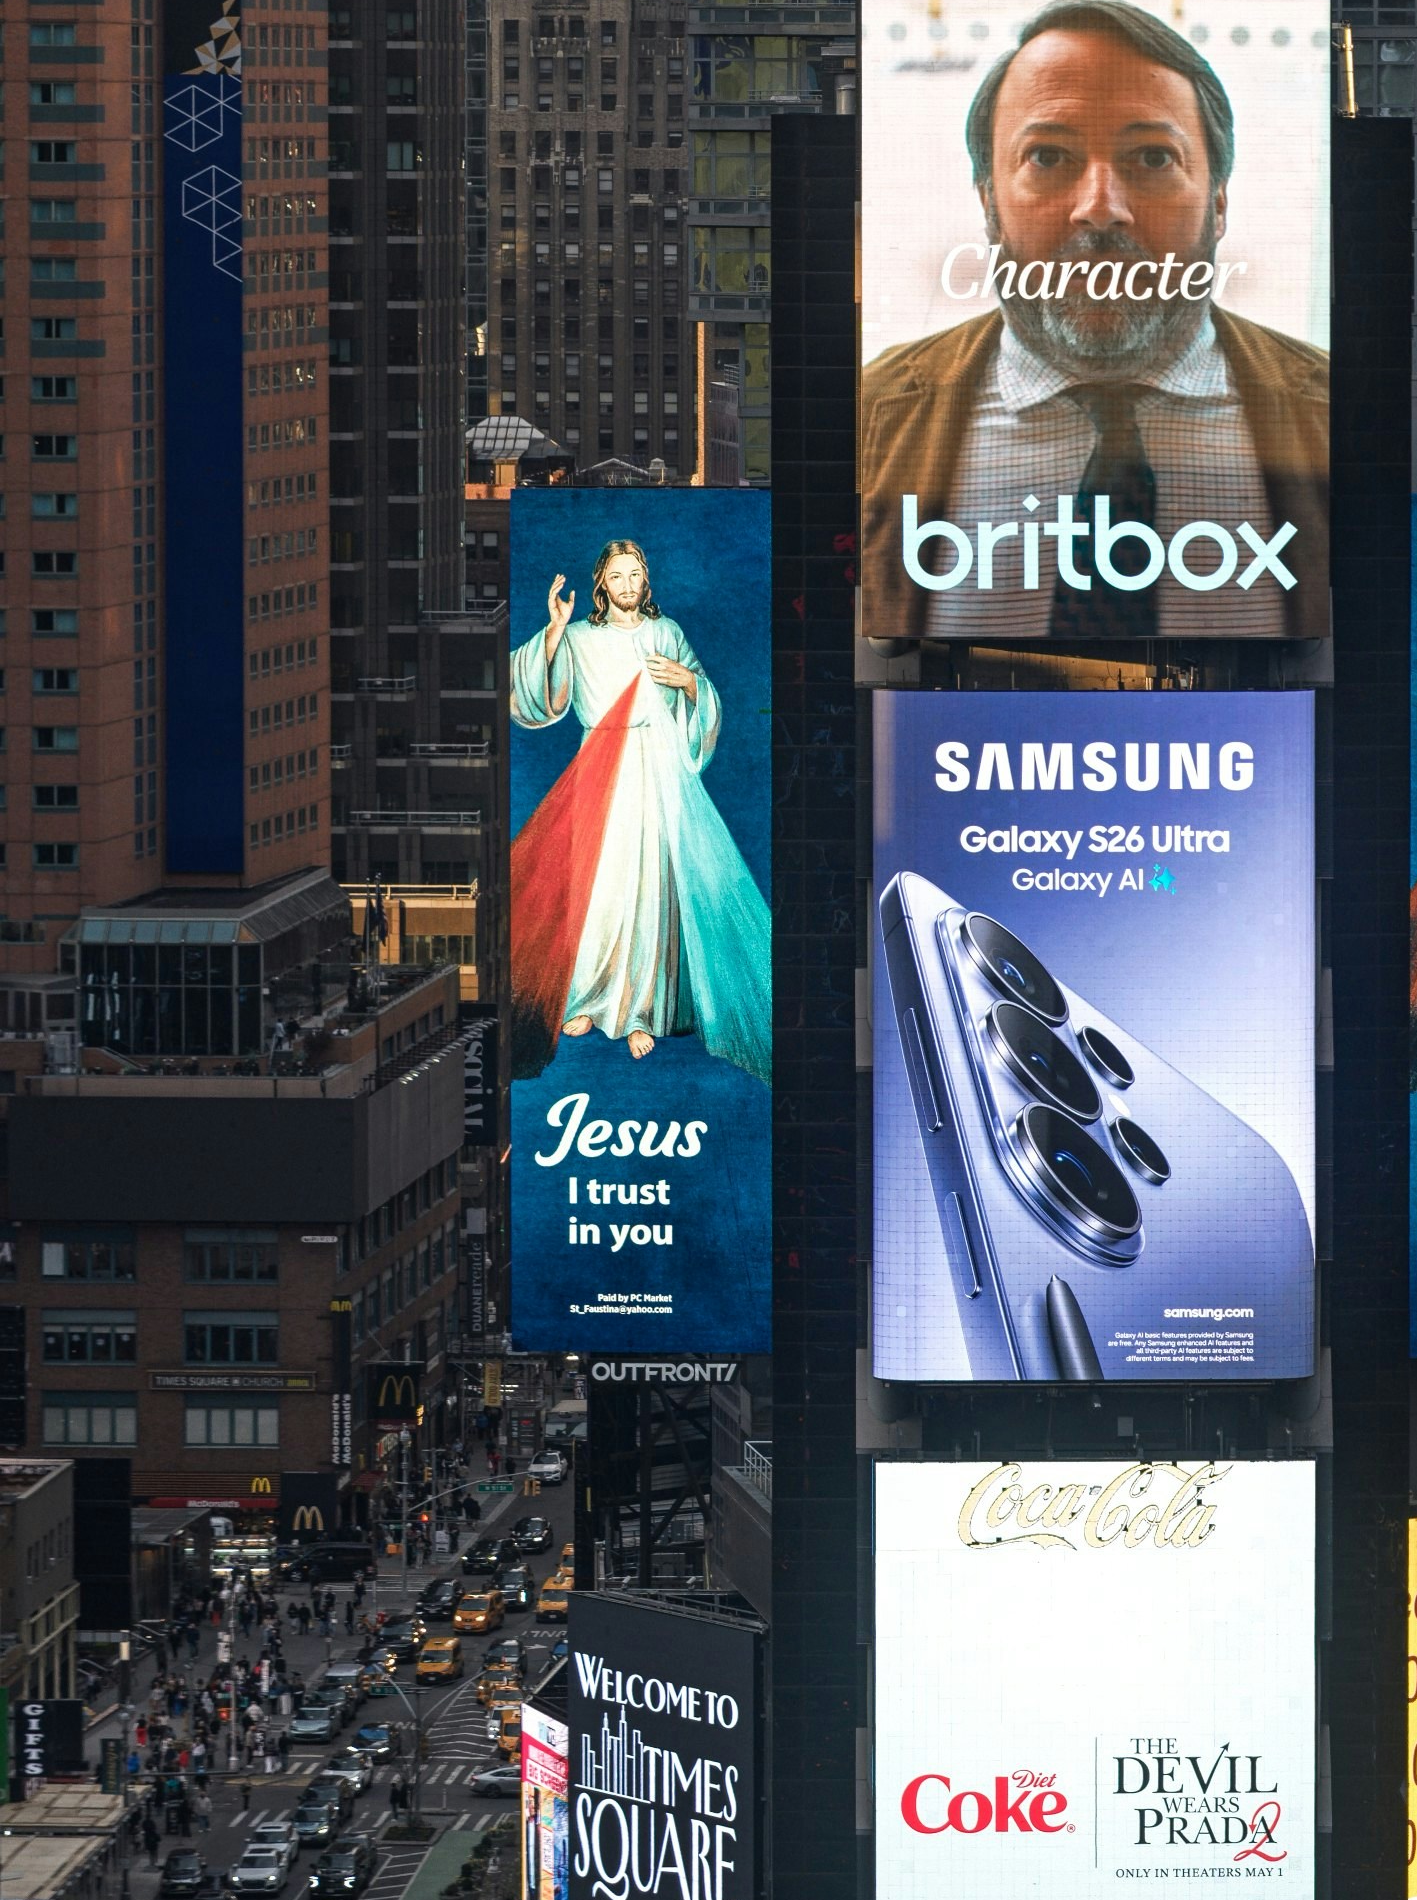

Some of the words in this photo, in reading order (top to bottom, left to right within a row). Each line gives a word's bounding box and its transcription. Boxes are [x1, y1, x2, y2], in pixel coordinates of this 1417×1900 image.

[940, 242, 1247, 302] Character
[902, 493, 1298, 593] britbox
[934, 741, 1256, 792] SAMSUNG
[960, 825, 1083, 859] Galaxy
[1088, 825, 1145, 853] S26
[1152, 825, 1231, 853] Ultra
[1012, 867, 1113, 897] Galaxy
[1118, 867, 1144, 891] AI
[535, 1092, 708, 1168] Jesus
[569, 1177, 578, 1205] I
[587, 1178, 671, 1206] trust
[569, 1216, 600, 1245] in
[609, 1223, 673, 1253] you
[569, 1304, 673, 1316] St_Faustina@yahoo.com
[597, 1293, 616, 1303] Paid
[618, 1293, 630, 1305] by
[630, 1293, 642, 1303] PC
[643, 1293, 672, 1303] Market
[1163, 1307, 1254, 1321] samsung.com
[155, 1376, 188, 1386] TIMES
[189, 1377, 230, 1387] SQUARE
[243, 1378, 283, 1387] CHURCH
[573, 1651, 702, 1722] WELCOME
[705, 1690, 740, 1730] TO
[22, 1703, 46, 1775] GIFTS
[1130, 1737, 1179, 1755] THE
[643, 1744, 740, 1823] TIMES
[1012, 1769, 1057, 1789] Diet
[1112, 1742, 1279, 1795] DEVIL
[900, 1773, 1068, 1835] Coke
[1162, 1797, 1240, 1814] WEARS
[1134, 1807, 1278, 1846] PRADA
[1233, 1801, 1288, 1862] 2
[1115, 1868, 1151, 1878] ONLY
[1155, 1868, 1169, 1878] IN
[1172, 1867, 1242, 1878] THEATERS
[1245, 1867, 1274, 1877] MAY
[1277, 1867, 1284, 1877] 1
